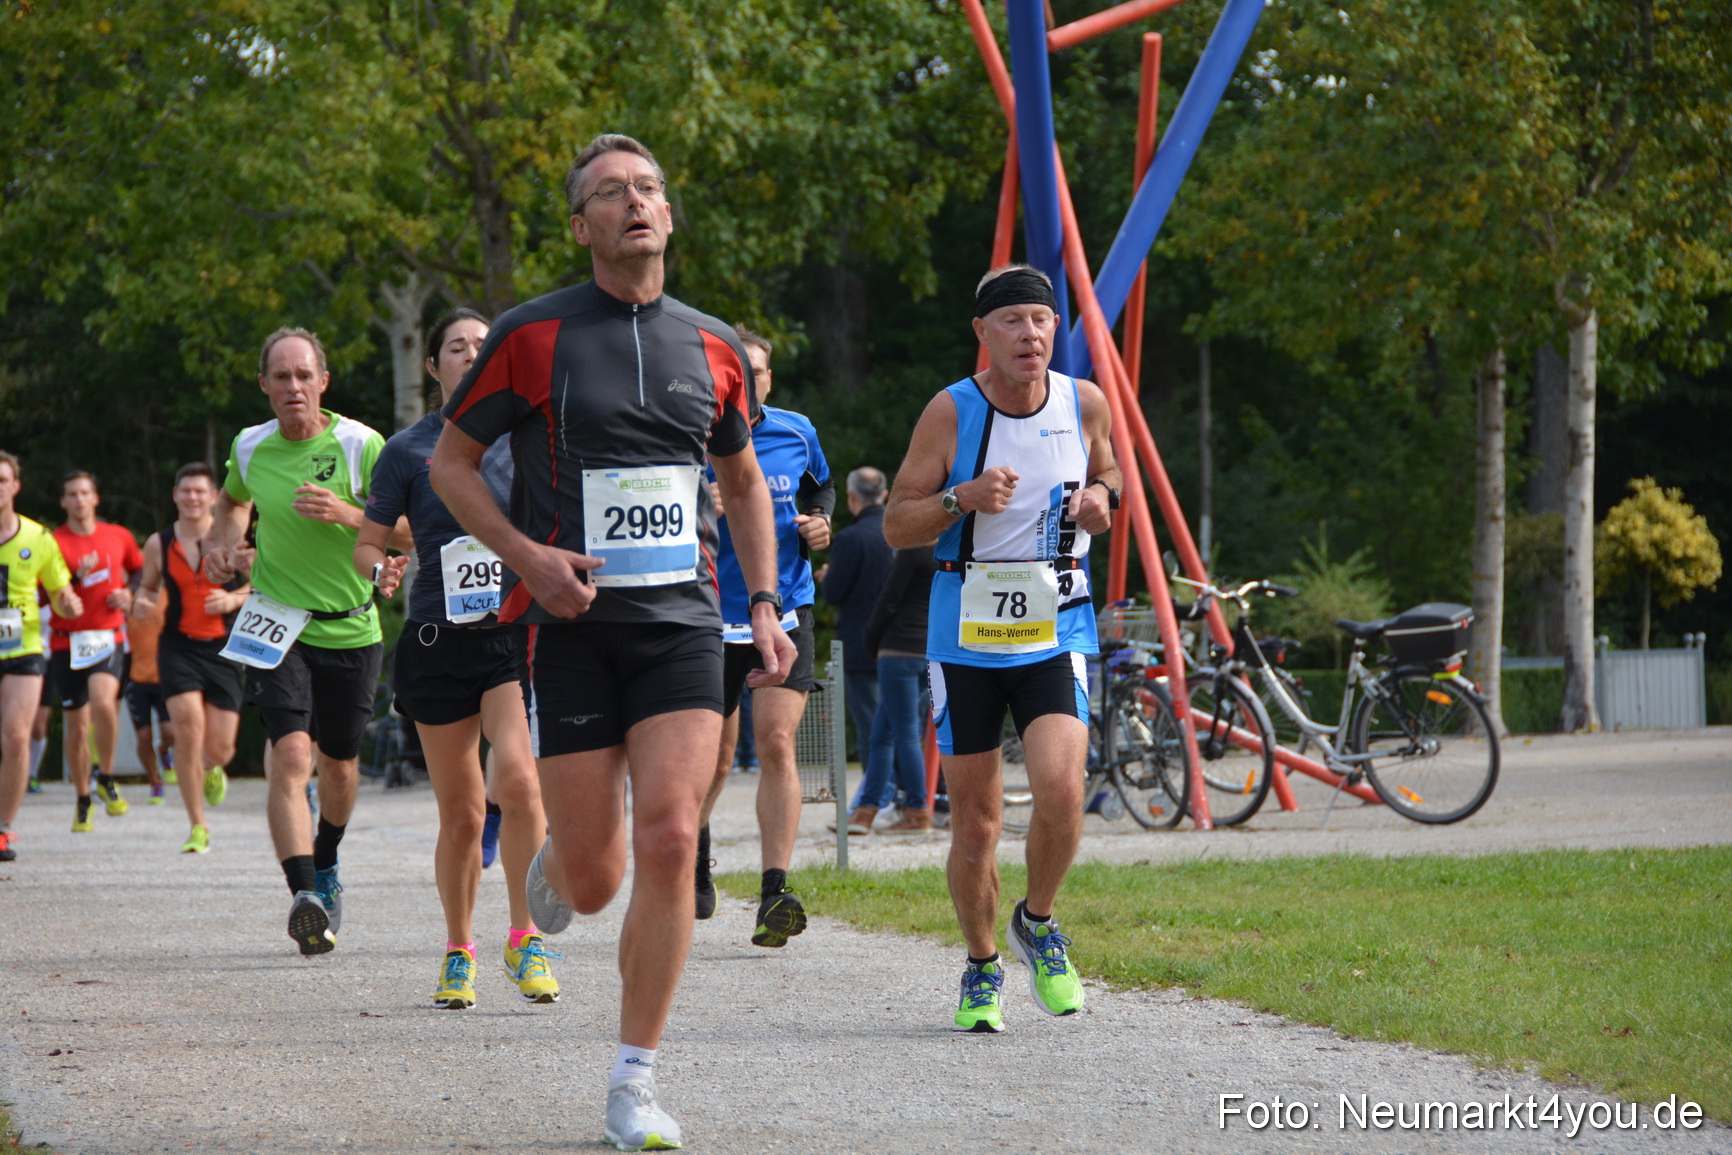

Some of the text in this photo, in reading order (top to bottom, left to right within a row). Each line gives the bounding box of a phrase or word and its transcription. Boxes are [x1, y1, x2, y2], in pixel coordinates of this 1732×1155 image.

[631, 478, 671, 489] BOCK
[604, 502, 684, 541] 2999
[1037, 509, 1047, 536] WASTE
[996, 571, 1031, 579] BOCK
[992, 591, 1028, 619] 78
[239, 610, 288, 644] 2276
[976, 626, 1040, 638] Hans-Werner
